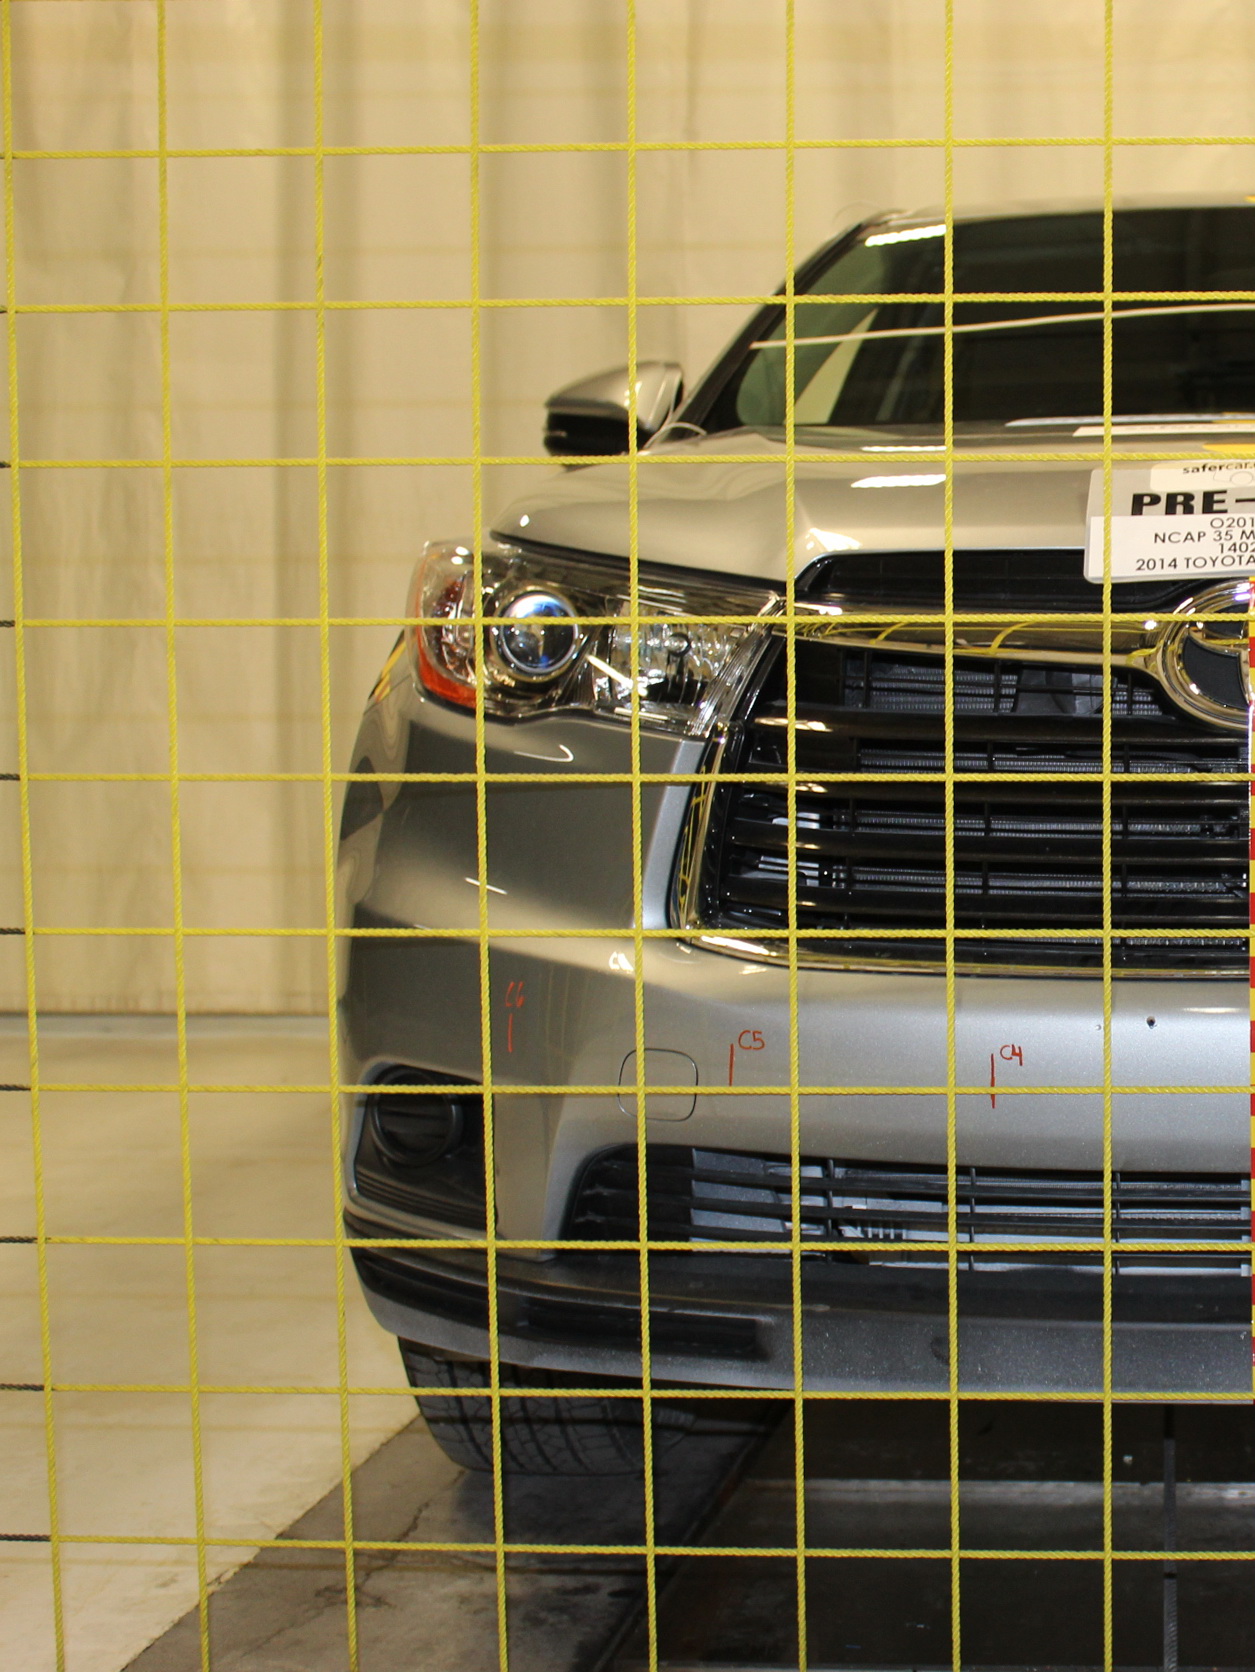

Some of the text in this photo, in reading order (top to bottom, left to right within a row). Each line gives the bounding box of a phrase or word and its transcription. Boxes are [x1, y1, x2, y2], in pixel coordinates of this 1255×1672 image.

[1154, 531, 1206, 544] NCAP
[1213, 530, 1233, 541] 35
[1136, 558, 1178, 571] 2014
[738, 1029, 766, 1051] C5
[999, 1043, 1023, 1067] C4
